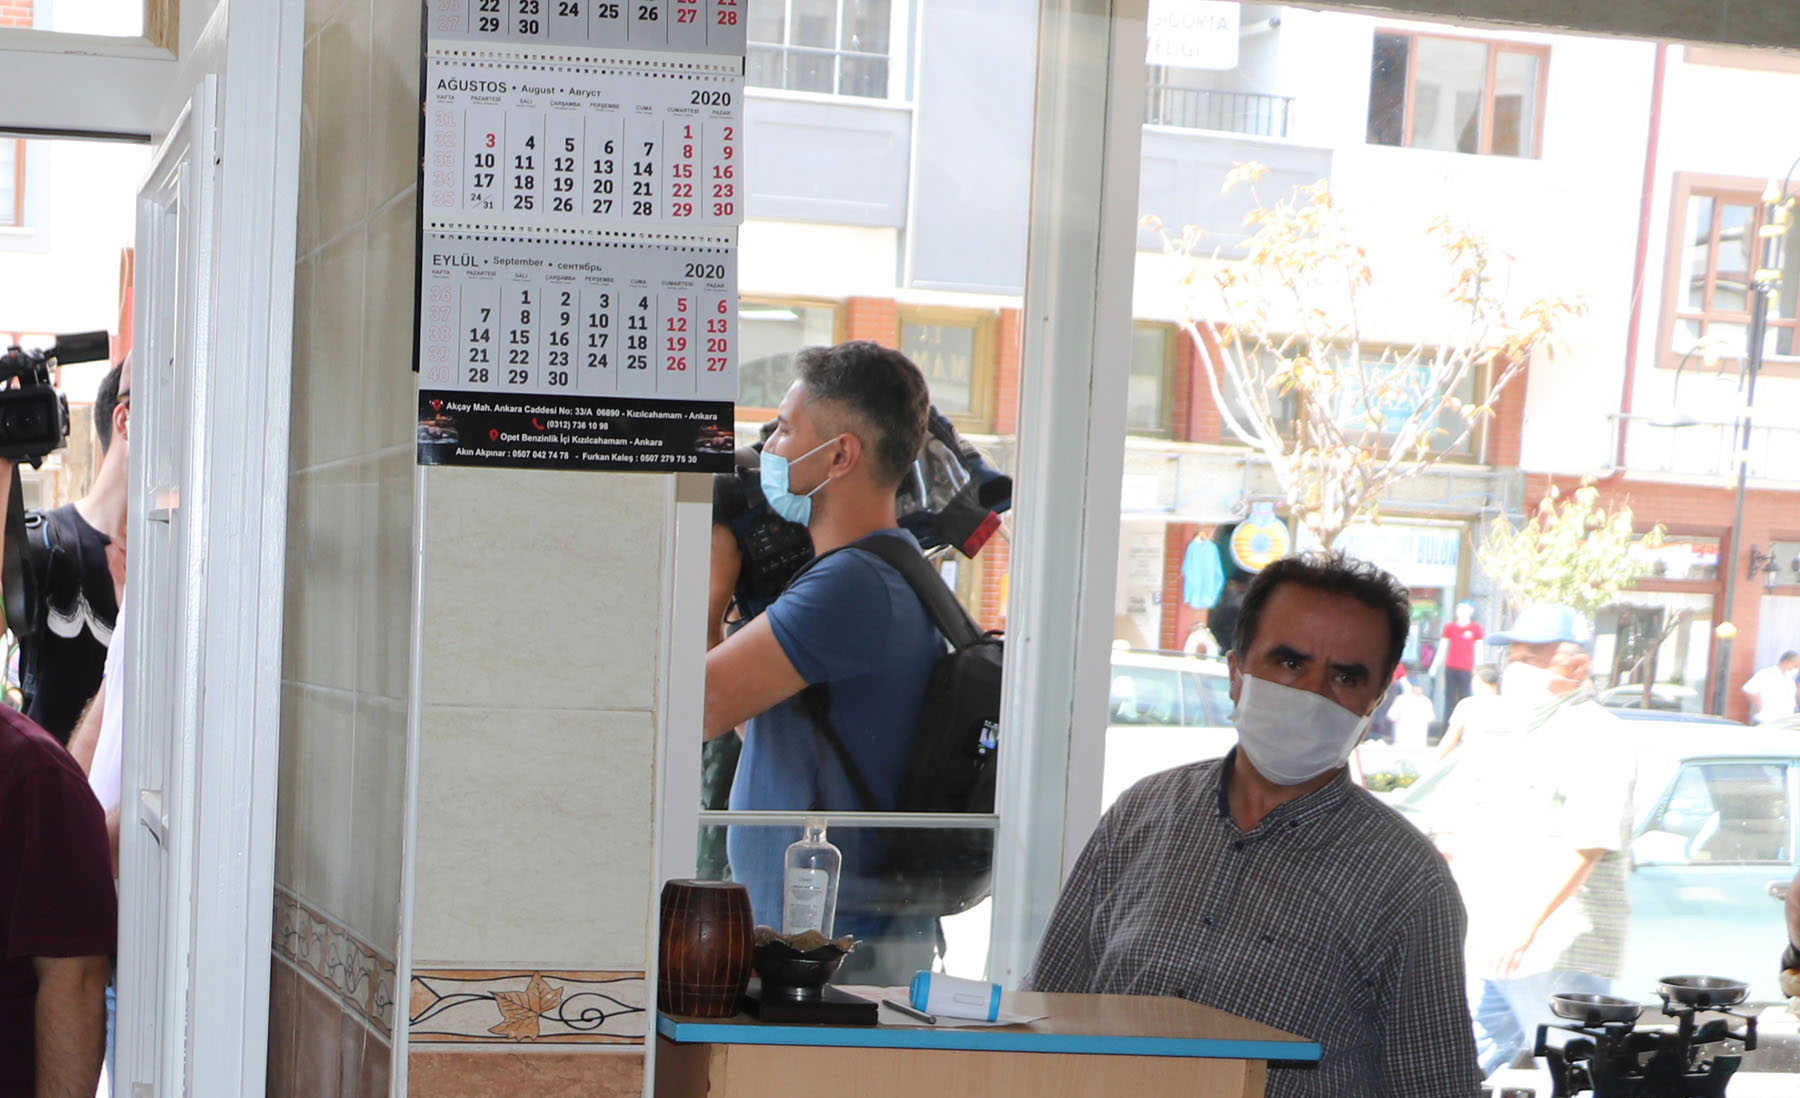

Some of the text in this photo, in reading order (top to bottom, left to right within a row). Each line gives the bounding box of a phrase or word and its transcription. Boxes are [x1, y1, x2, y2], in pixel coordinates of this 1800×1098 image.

[479, 0, 737, 25] 22 23 24 25 26 27 28
[479, 17, 499, 32] 29
[519, 19, 539, 35] 30
[436, 78, 508, 94] AĞUSTOS
[521, 84, 556, 96] August
[690, 90, 732, 107] 2020
[684, 125, 693, 139] 1
[723, 126, 733, 141] 2
[486, 133, 495, 148] 3
[525, 136, 535, 150] 4
[565, 138, 575, 152] 5
[604, 140, 614, 155] 6
[644, 142, 654, 156] 7
[683, 144, 693, 159] 8
[723, 146, 733, 160] 9
[475, 153, 495, 168] 10
[515, 155, 534, 170] 11
[554, 157, 574, 172] 12
[594, 159, 613, 174] 13
[633, 162, 653, 176] 14
[673, 164, 692, 178] 15
[713, 165, 733, 179] 16
[474, 173, 494, 188] 17
[514, 175, 534, 190] 18
[554, 177, 574, 192] 19
[593, 179, 613, 194] 20
[633, 181, 653, 196] 21
[672, 183, 692, 198] 22
[713, 184, 733, 198] 23
[471, 194, 481, 202] 24
[483, 201, 493, 209] 31
[513, 195, 534, 210] 25
[553, 197, 573, 212] 26
[593, 199, 613, 214] 27
[633, 201, 652, 216] 28
[672, 202, 692, 217] 29
[713, 202, 734, 216] 30
[433, 253, 725, 279] EYLÜL September сентябрь 2020
[521, 290, 531, 304] 1
[561, 291, 570, 306] 2
[600, 294, 609, 308] 3
[638, 296, 648, 310] 4
[678, 298, 687, 312] 5
[717, 299, 727, 314] 6
[481, 308, 491, 323] 7
[520, 310, 530, 325] 8
[560, 311, 570, 326] 9
[589, 313, 609, 328] 10
[628, 315, 648, 330] 11
[667, 317, 687, 332] 12
[707, 319, 727, 333] 13
[470, 328, 490, 343] 14
[510, 329, 530, 345] 15
[550, 331, 569, 346] 16
[588, 333, 608, 348] 17
[628, 335, 647, 350] 18
[667, 337, 687, 351] 19
[707, 338, 727, 353] 20
[469, 348, 489, 363] 21
[509, 349, 529, 364] 22
[549, 351, 569, 366] 23
[588, 353, 608, 368] 24
[627, 354, 647, 370] 25
[667, 356, 687, 371] 26
[707, 357, 728, 372] 27
[468, 368, 489, 383] 28
[508, 369, 528, 384] 29
[548, 371, 568, 386] 30
[446, 402, 471, 413] Akçay
[473, 403, 492, 412] Mah.
[494, 404, 522, 413] Ankara
[524, 405, 557, 414] Caddesi
[559, 407, 572, 415] No:
[575, 408, 592, 416] 33/A
[627, 410, 682, 419] Kızılcahamam
[689, 412, 717, 420] Ankara
[547, 420, 571, 430] (0312)
[573, 421, 586, 429] 736
[588, 422, 597, 430] 10
[500, 433, 662, 446] Opet Benzinlik İçi Kızılcahamam Ankara
[456, 447, 697, 463] Akın Akpınar 0507 042 74 78 Furkan Keleş 0507 279 75 30
